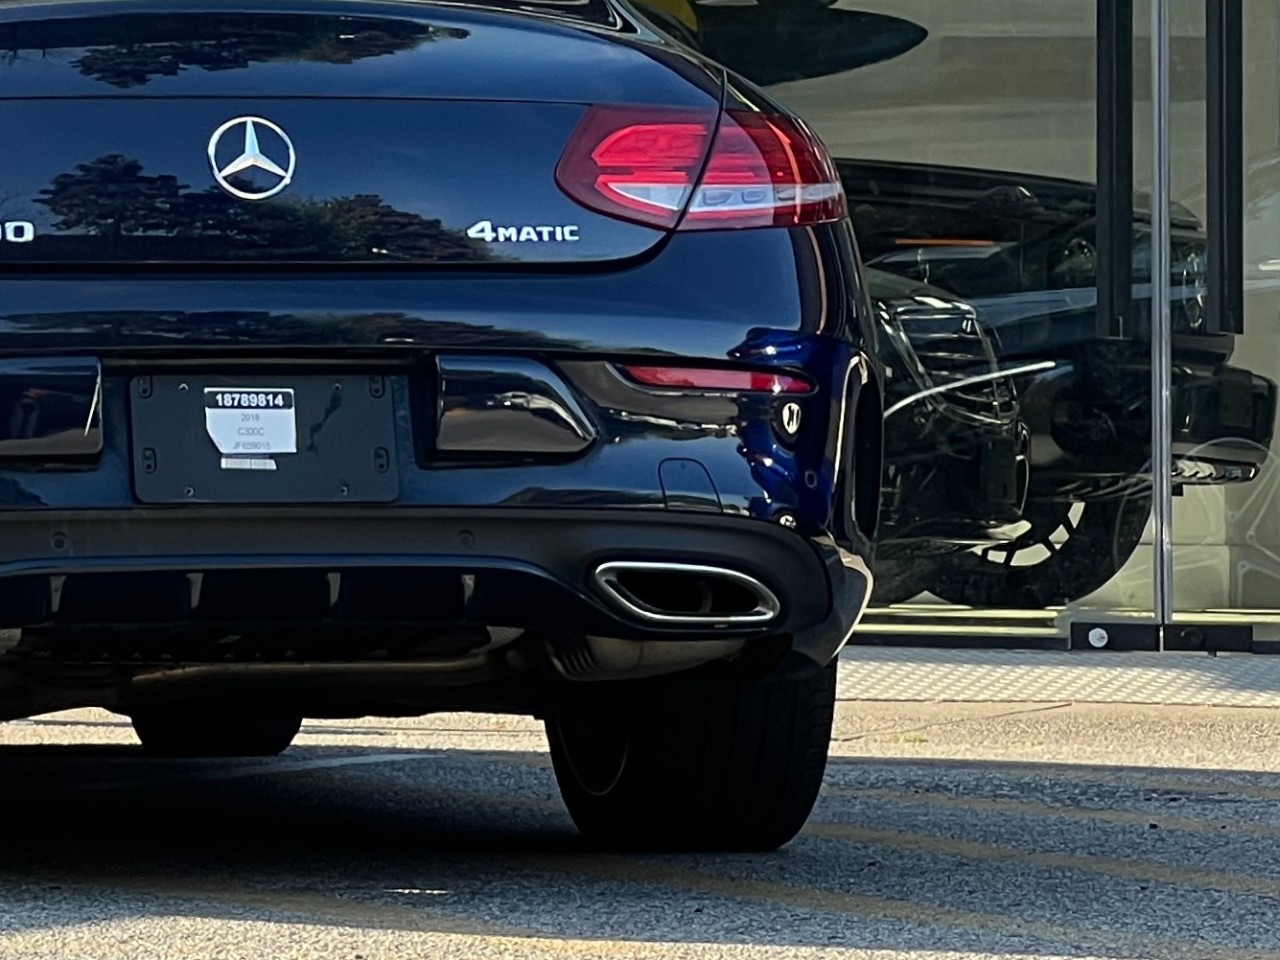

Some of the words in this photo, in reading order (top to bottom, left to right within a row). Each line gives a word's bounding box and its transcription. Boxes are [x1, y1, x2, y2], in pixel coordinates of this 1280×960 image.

[466, 220, 580, 242] 4MATIC
[215, 393, 284, 407] 18789814
[240, 413, 261, 422] 2018
